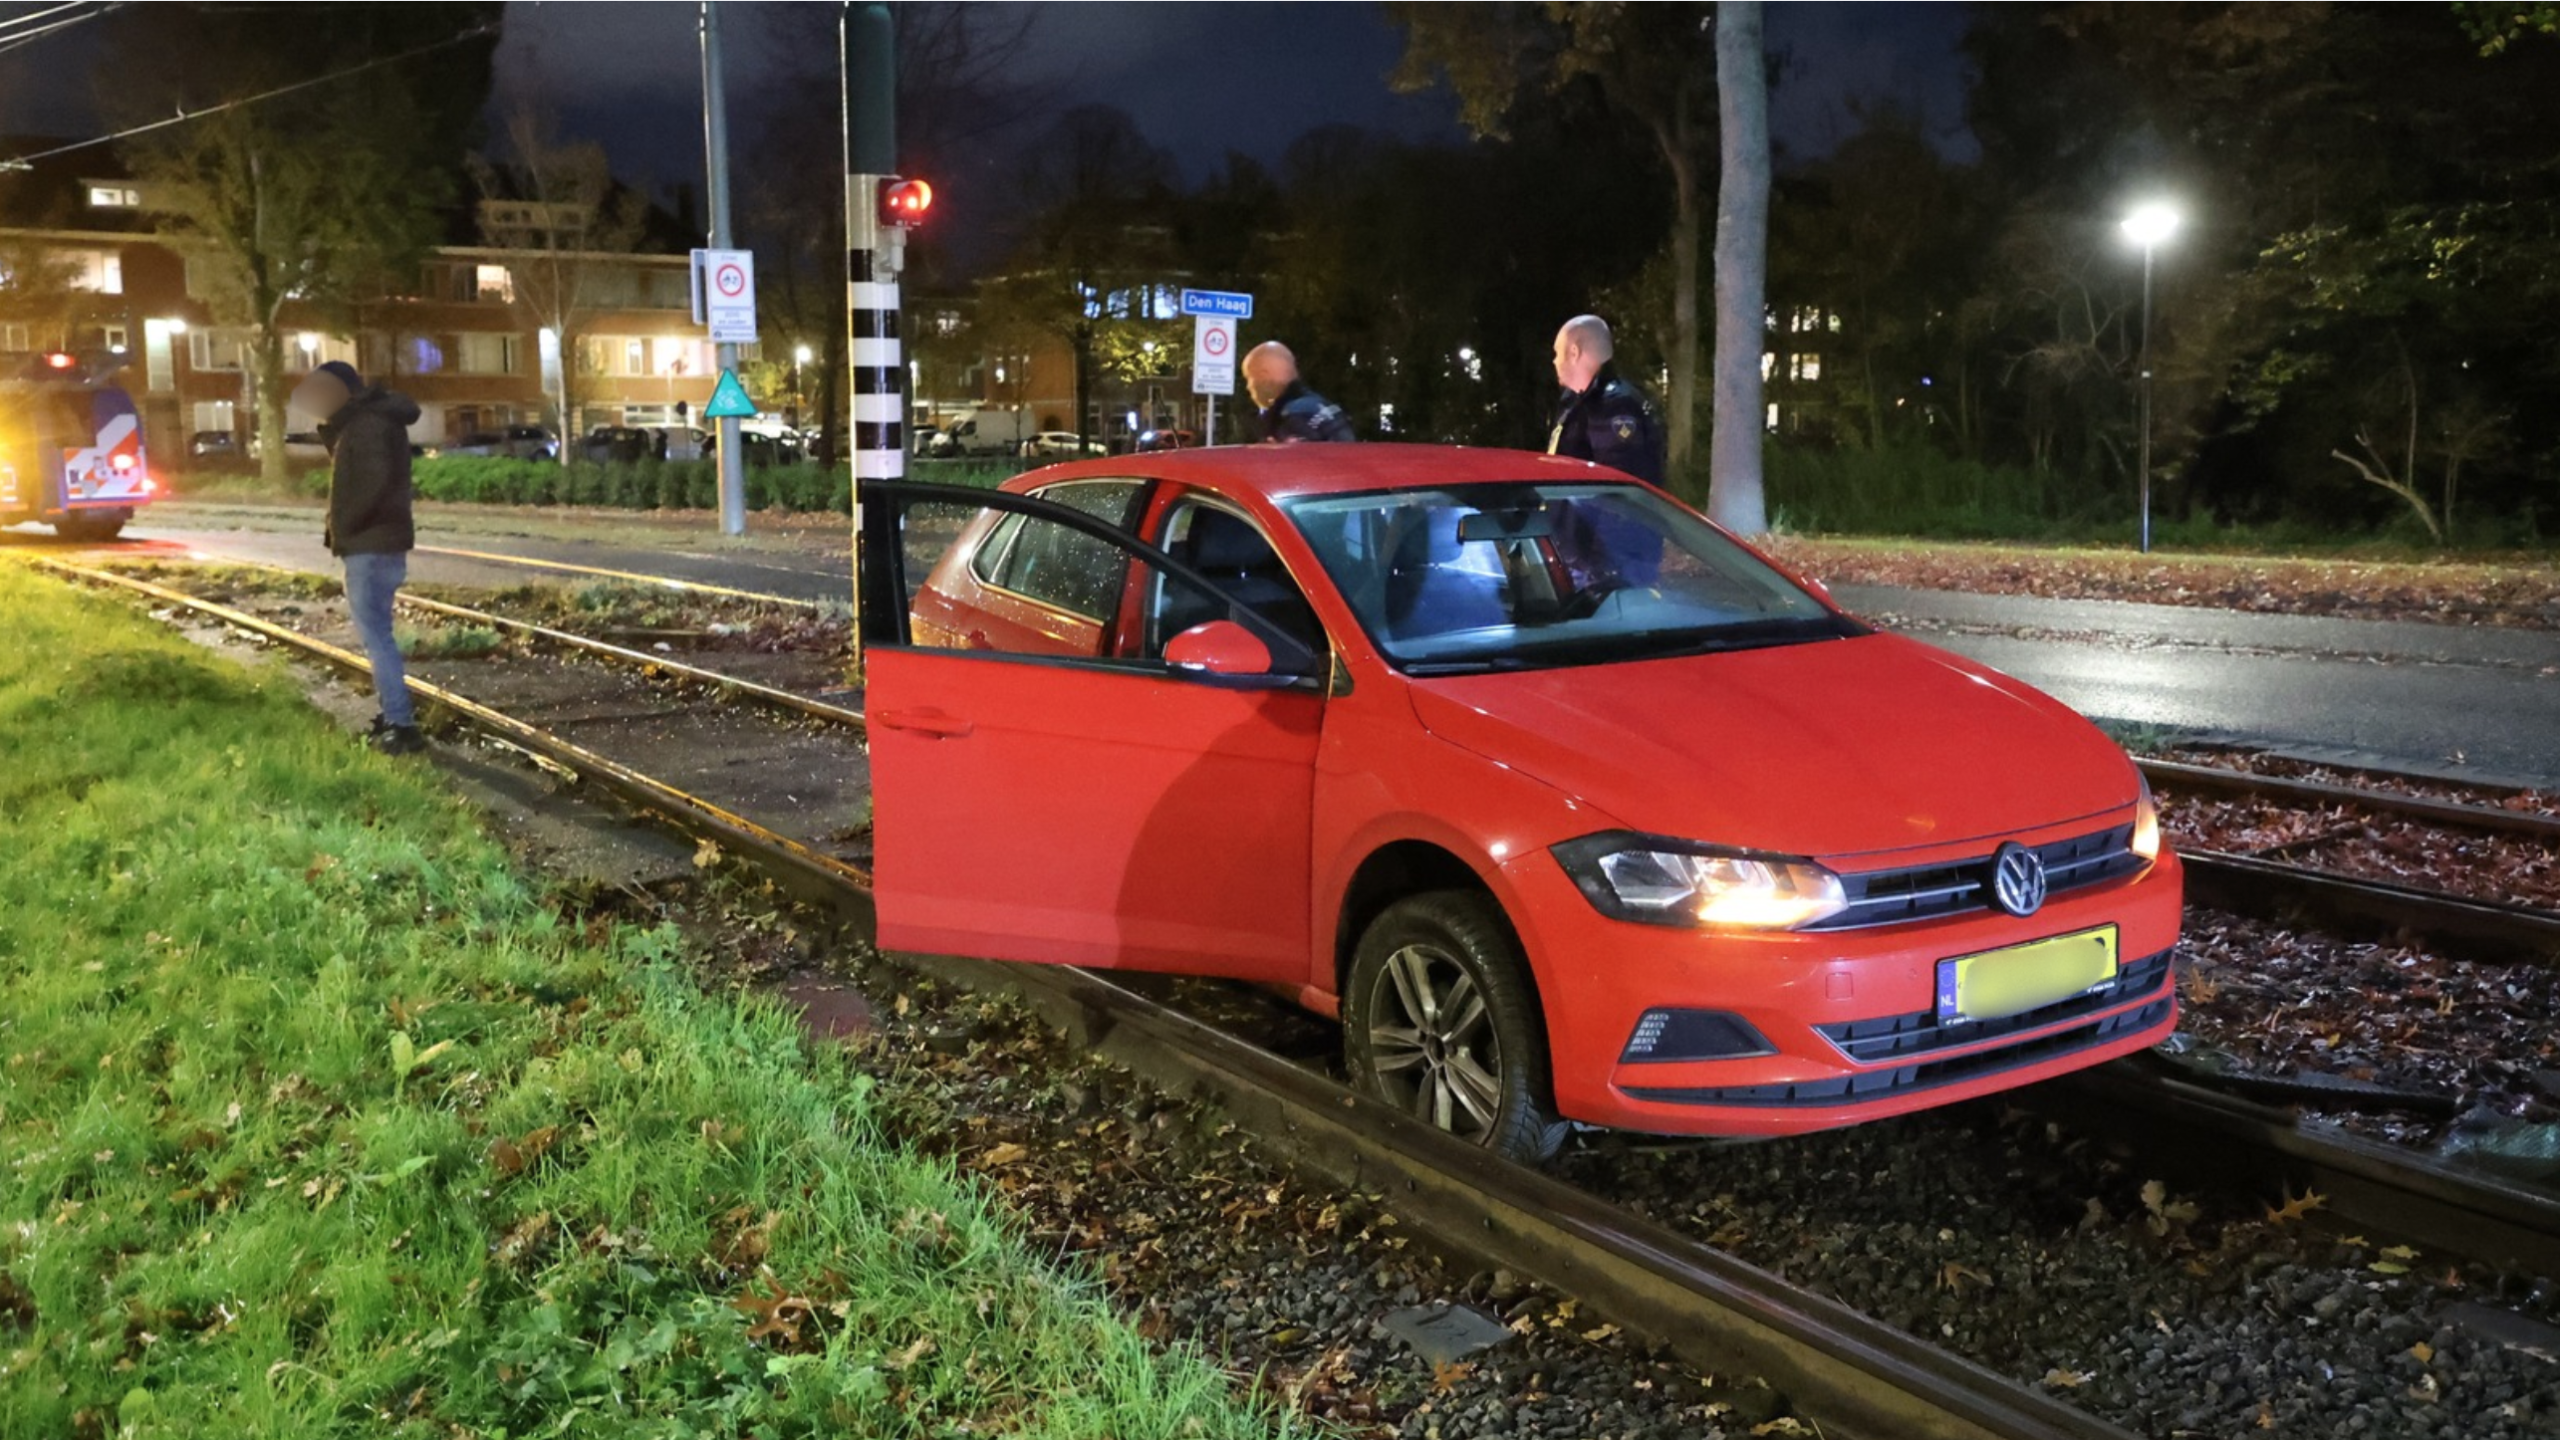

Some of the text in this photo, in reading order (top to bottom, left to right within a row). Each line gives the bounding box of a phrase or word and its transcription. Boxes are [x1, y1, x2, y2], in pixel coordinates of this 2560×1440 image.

[1188, 294, 1247, 315] Den Haag
[1940, 994, 1955, 1008] NL
